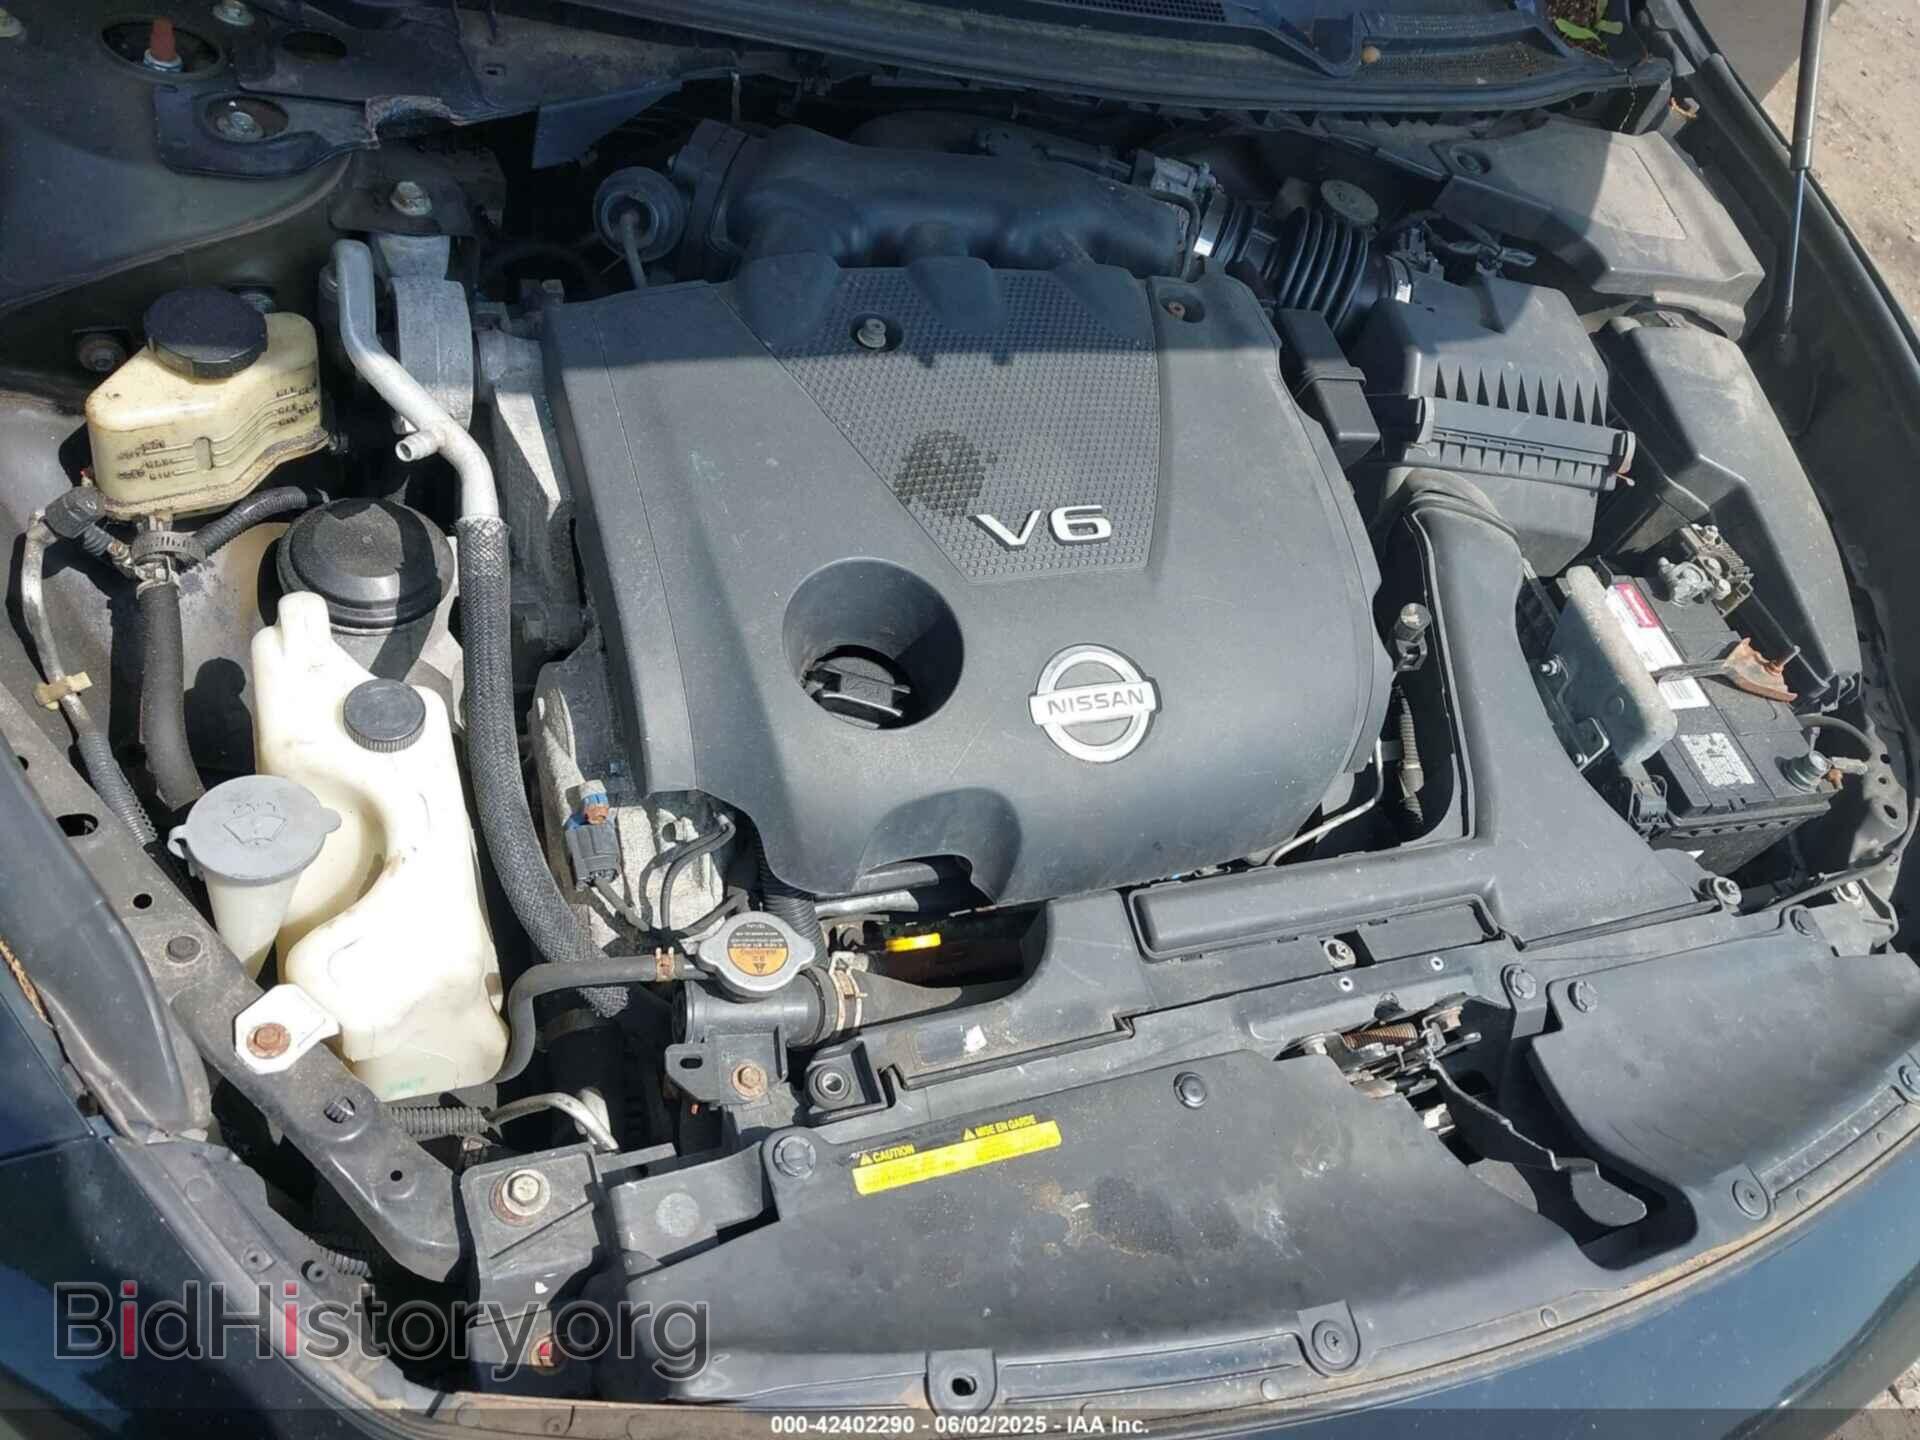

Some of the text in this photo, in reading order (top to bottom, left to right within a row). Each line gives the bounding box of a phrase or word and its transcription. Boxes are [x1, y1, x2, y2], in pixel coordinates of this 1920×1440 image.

[973, 504, 1113, 549] V6
[1047, 688, 1145, 716] NISSAN
[872, 1143, 916, 1163] CAUTION
